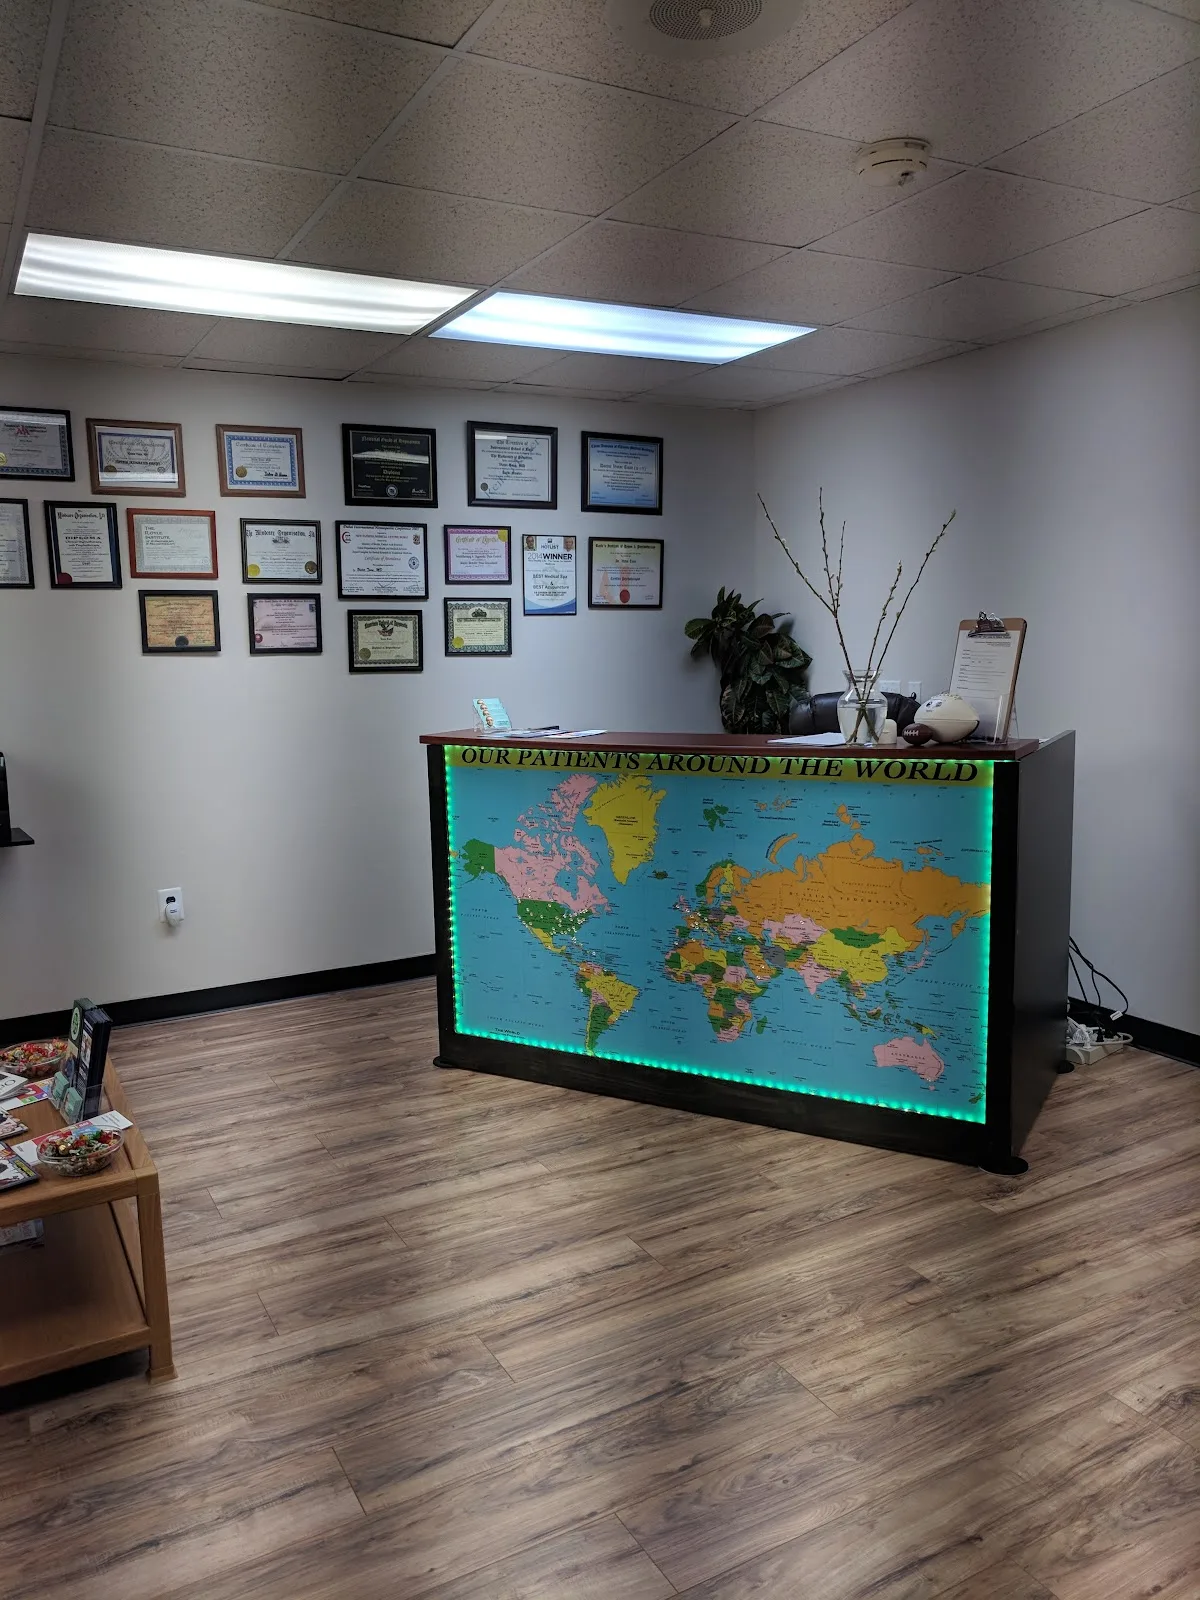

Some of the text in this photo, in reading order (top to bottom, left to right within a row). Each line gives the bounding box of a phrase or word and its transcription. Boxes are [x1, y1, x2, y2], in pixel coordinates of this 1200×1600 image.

[461, 747, 979, 782] OUR PATIENTS AROUND THE WORLD
